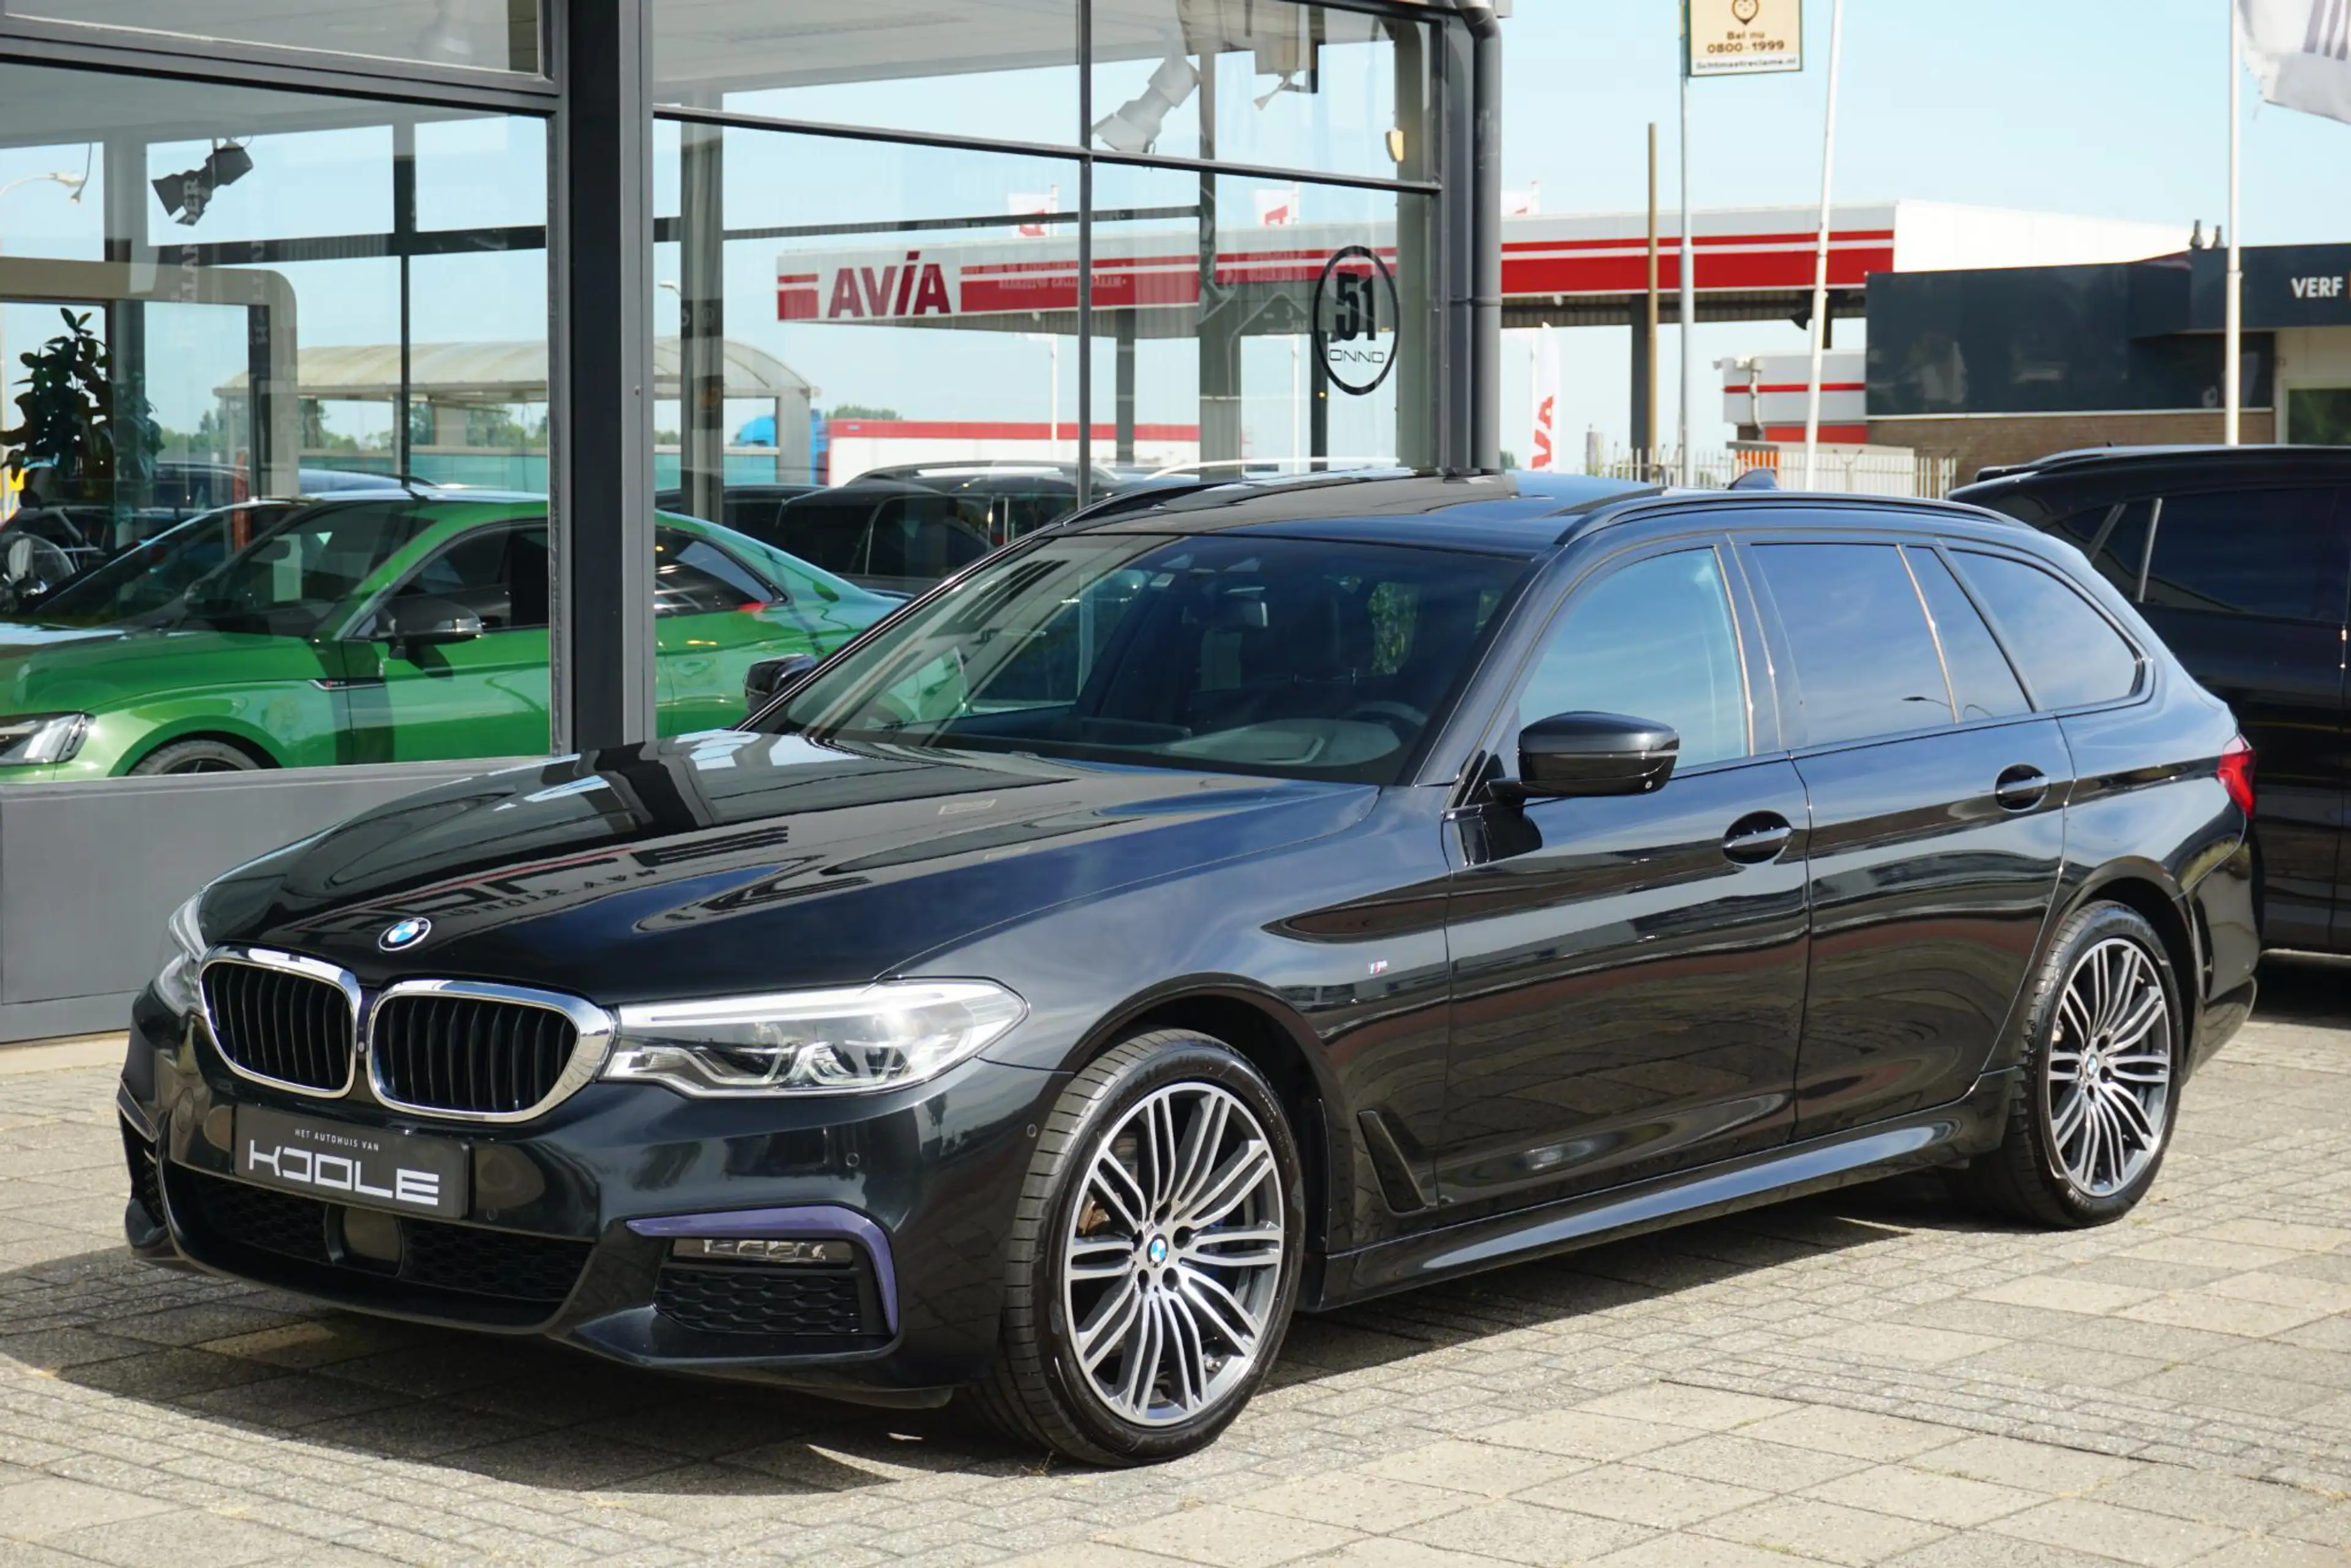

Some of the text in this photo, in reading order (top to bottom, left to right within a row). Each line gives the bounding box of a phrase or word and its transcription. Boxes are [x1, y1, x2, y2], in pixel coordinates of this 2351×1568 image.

[2290, 276, 2344, 299] VERF
[1335, 271, 1376, 341] 51
[1329, 348, 1385, 364] ONNO
[294, 1128, 380, 1152] HET AUTOHUIS VAN
[248, 1139, 440, 1206] KOOLE
